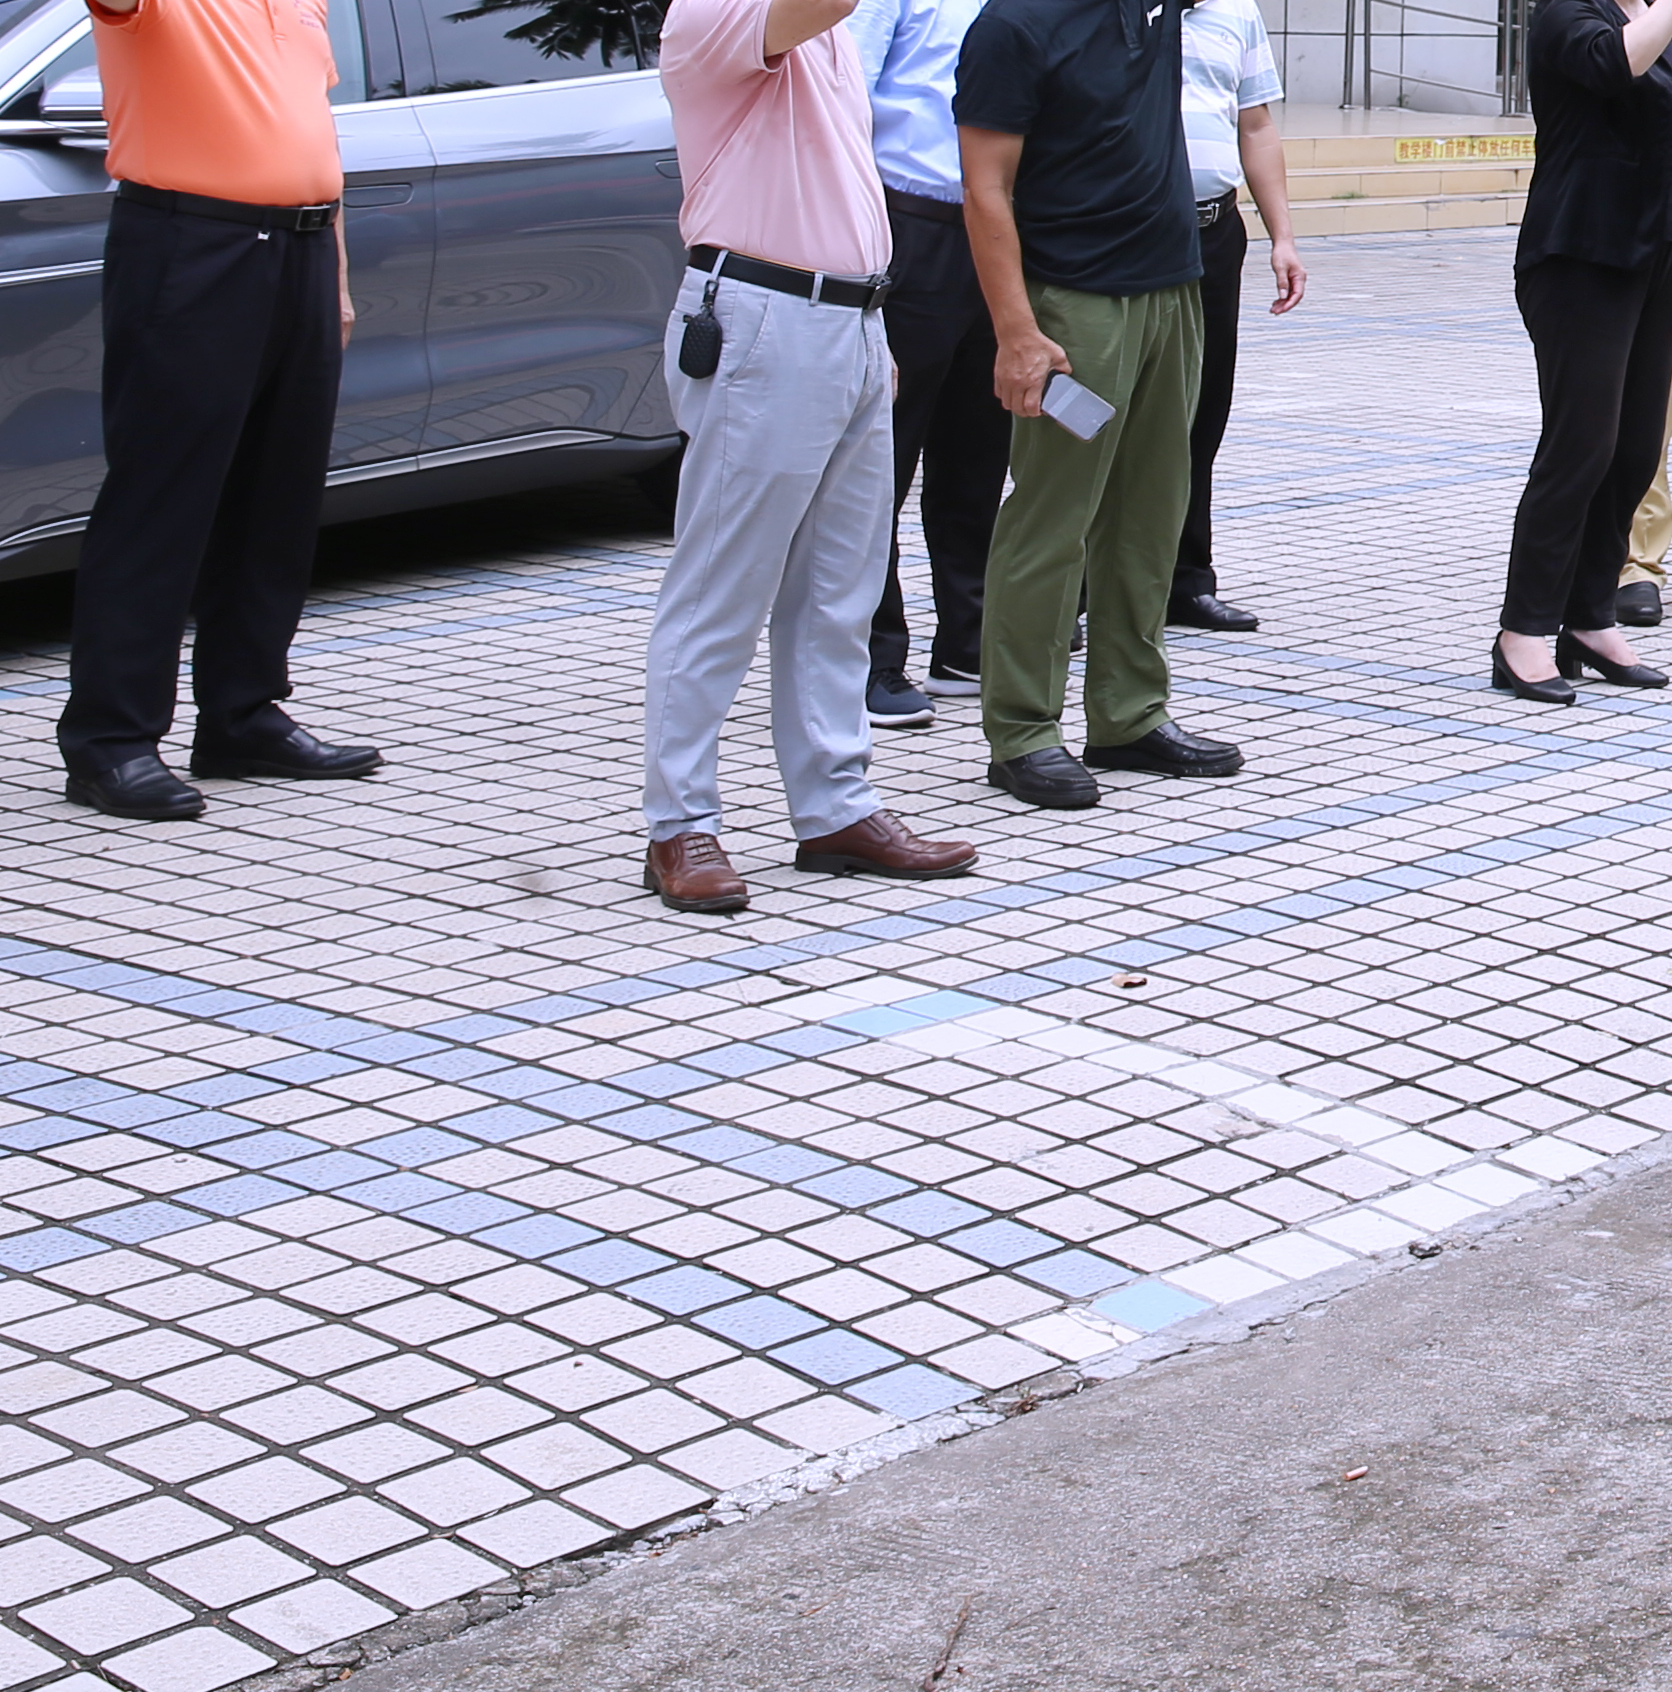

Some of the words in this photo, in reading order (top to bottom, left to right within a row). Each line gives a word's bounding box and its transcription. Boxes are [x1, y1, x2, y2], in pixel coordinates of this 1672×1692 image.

[1400, 139, 1536, 160] 教学楼门前禁止停放任何车
